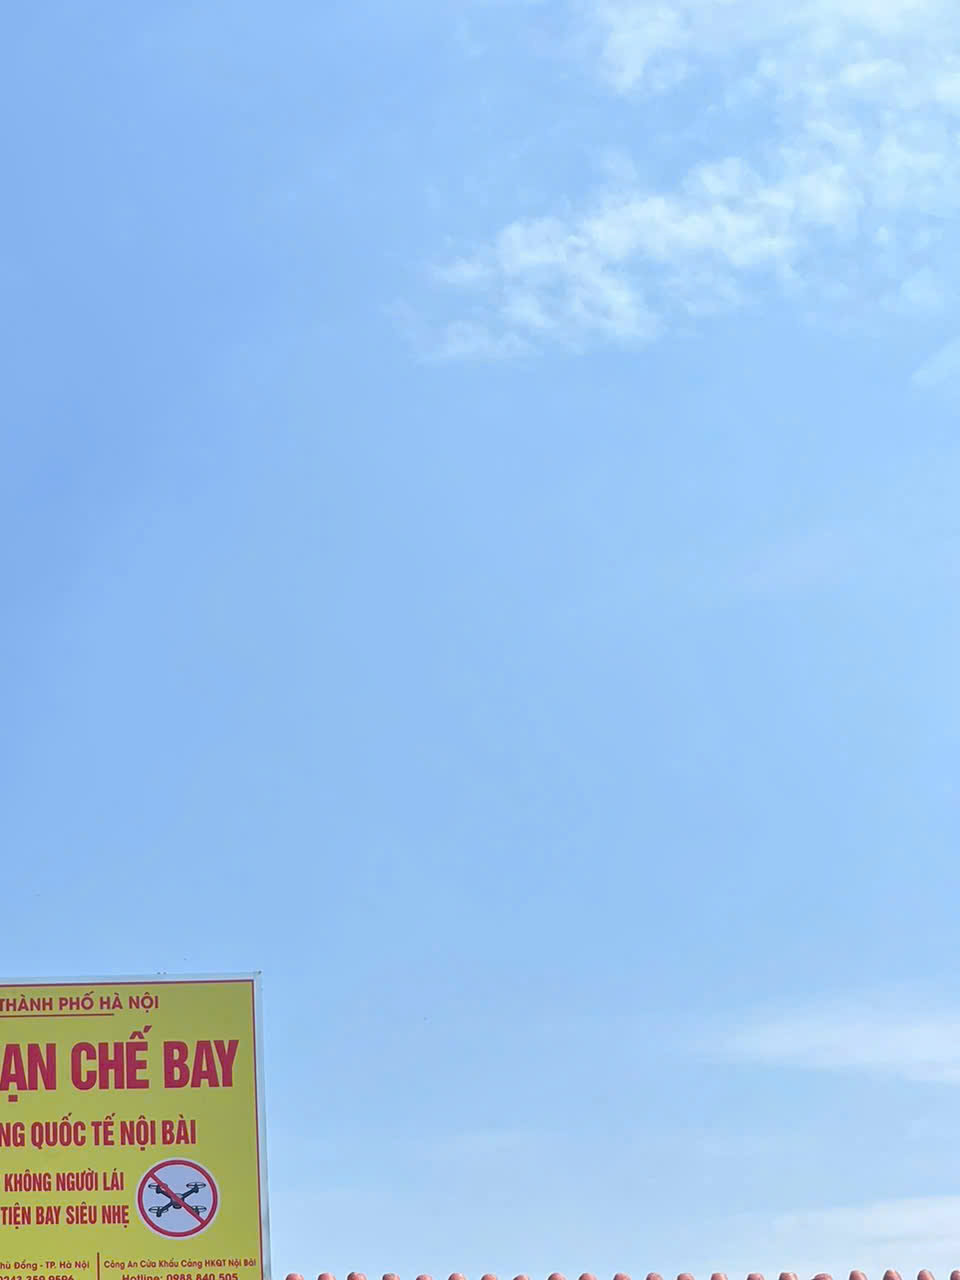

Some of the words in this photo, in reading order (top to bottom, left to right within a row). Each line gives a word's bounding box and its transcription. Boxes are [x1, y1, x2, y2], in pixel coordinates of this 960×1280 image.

[59, 991, 94, 1010] PHỐ
[100, 993, 123, 1009] HÀ
[129, 994, 158, 1013] NỘI
[71, 1026, 152, 1090] CHẾ
[164, 1040, 239, 1088] BAY
[31, 1113, 85, 1149] QUỐC
[91, 1113, 115, 1145] TẾ
[120, 1115, 156, 1151] NỘI
[162, 1116, 196, 1144] BÀI
[5, 1169, 51, 1192] KHÔNG
[56, 1168, 98, 1191] NGƯỜI
[103, 1168, 124, 1191] LÁI
[1, 1204, 31, 1229] TIỆN
[36, 1206, 61, 1224] BAY
[66, 1202, 97, 1224] SIÊU
[102, 1205, 129, 1228] NHẸ
[46, 1260, 57, 1269] TP.
[128, 1260, 138, 1268] An
